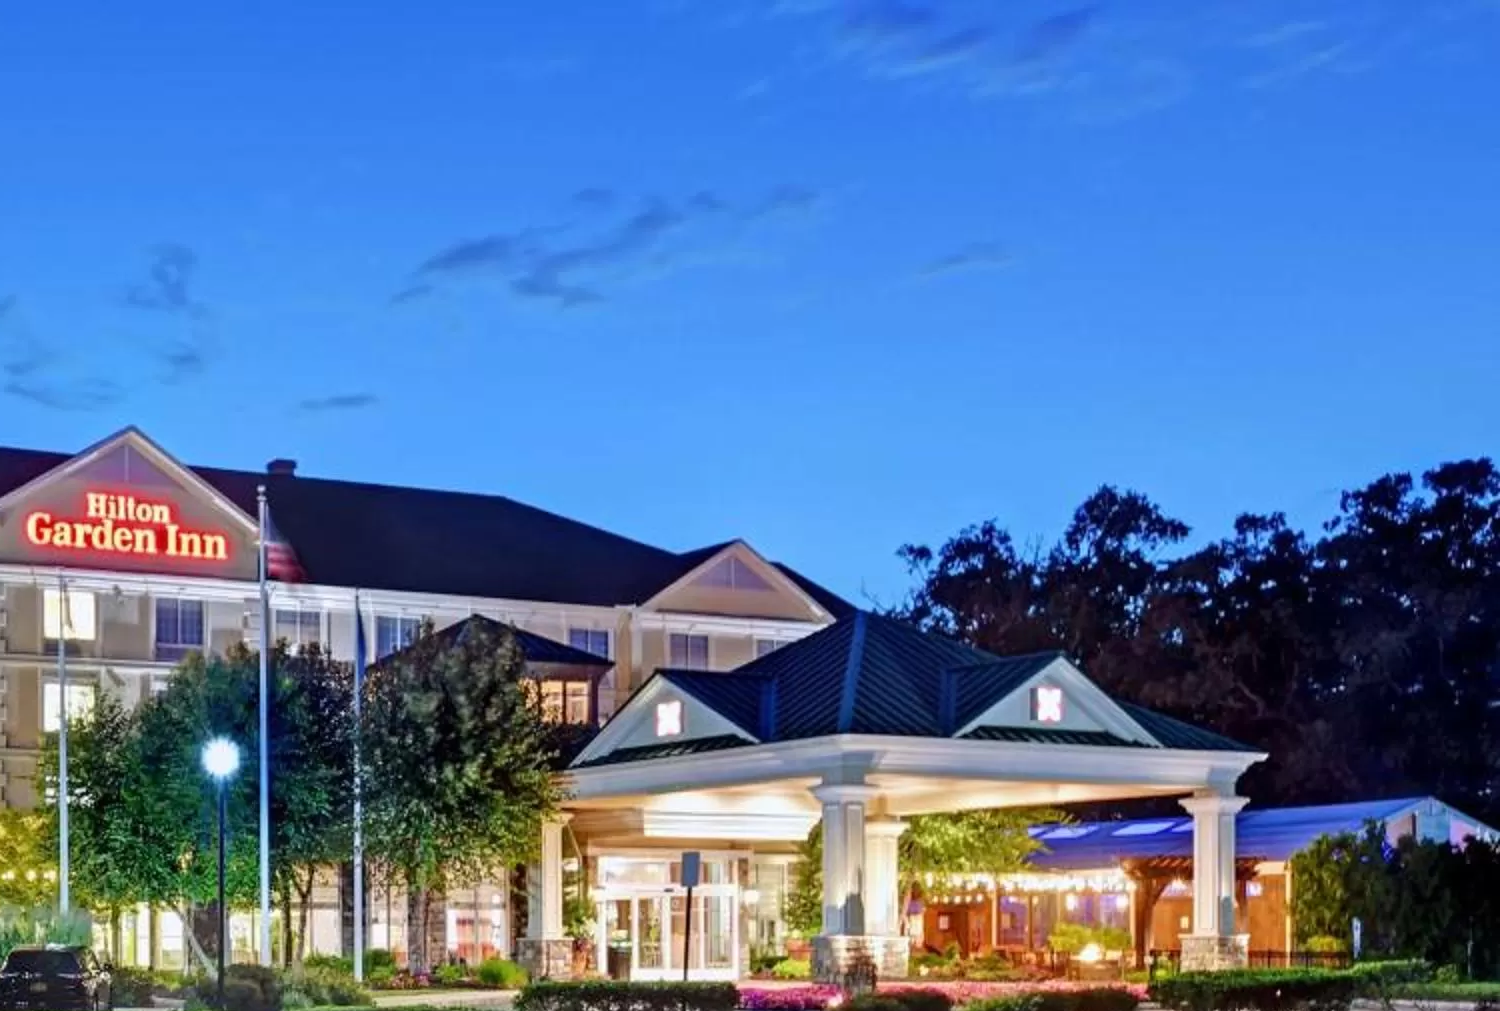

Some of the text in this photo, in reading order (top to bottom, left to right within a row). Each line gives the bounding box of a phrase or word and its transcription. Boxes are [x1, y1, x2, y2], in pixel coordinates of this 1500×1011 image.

[86, 492, 171, 525] Hilton
[26, 512, 228, 560] Garden Inn
